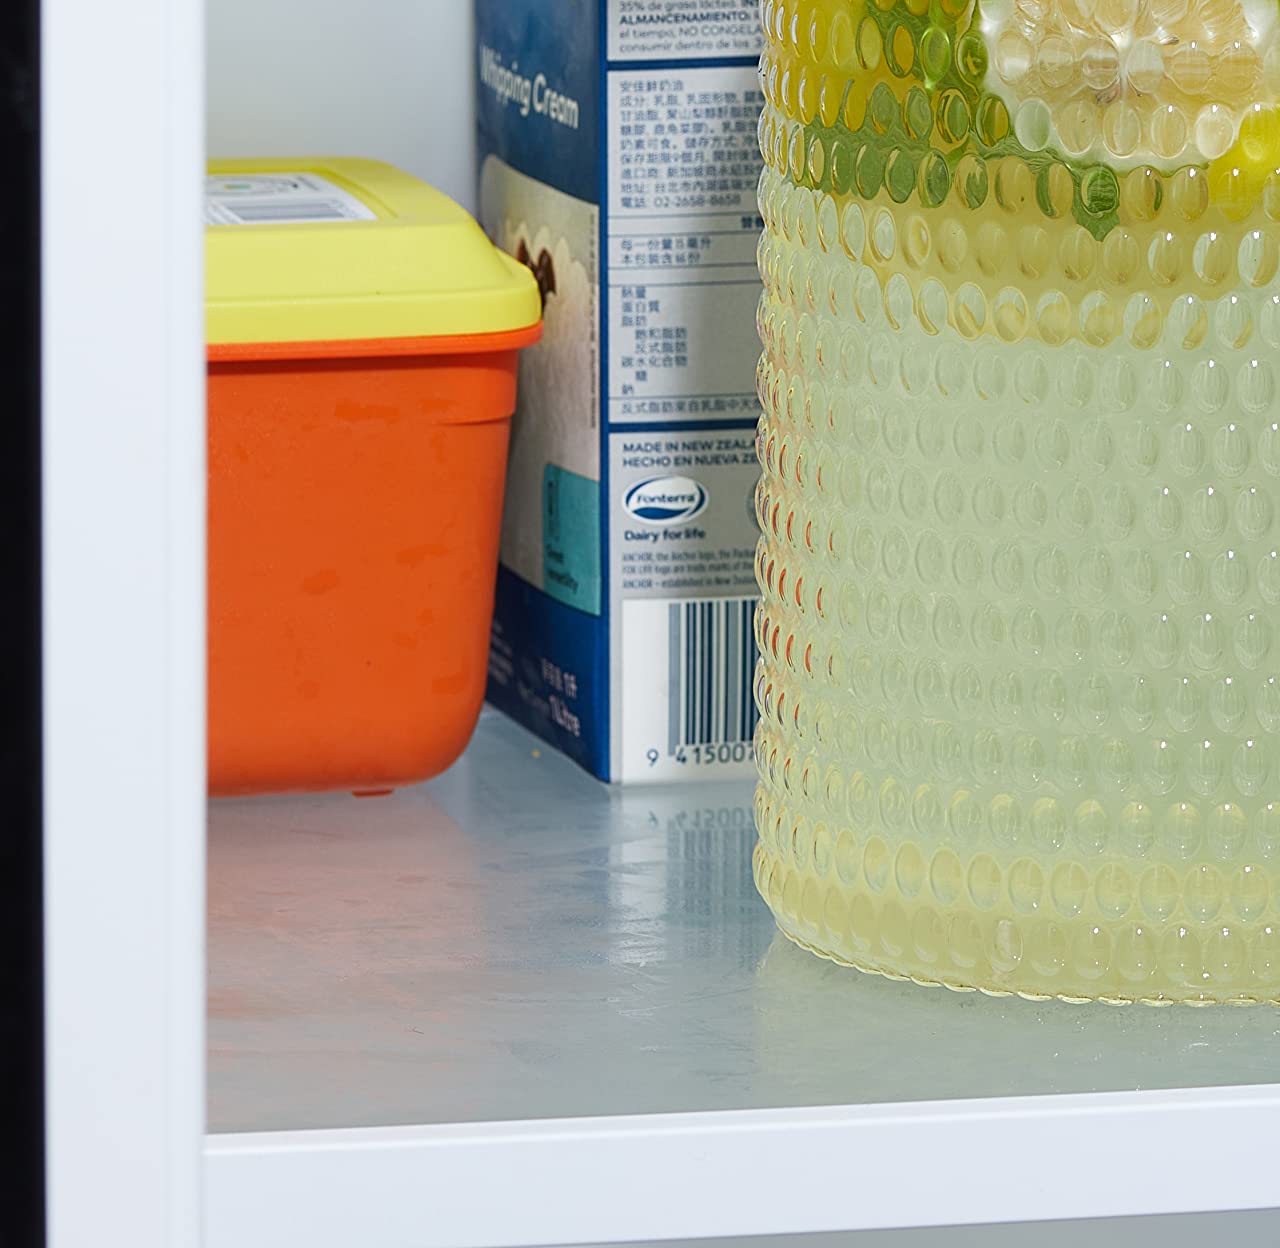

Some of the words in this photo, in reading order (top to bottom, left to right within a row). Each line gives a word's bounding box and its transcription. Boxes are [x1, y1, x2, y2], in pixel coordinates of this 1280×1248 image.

[648, 0, 662, 11] de
[620, 28, 630, 38] el
[678, 27, 698, 37] NO
[620, 40, 673, 53] consumir
[675, 38, 712, 49] dentro
[715, 38, 729, 49] de
[480, 45, 531, 117] Whipping
[533, 73, 580, 129] Cream
[623, 441, 661, 453] MADE
[665, 440, 678, 452] IN
[681, 439, 714, 452] NEW
[623, 455, 671, 467] HECHO
[674, 454, 692, 466] EN
[695, 453, 740, 465] NUEVA
[637, 493, 697, 504] Fonterra
[624, 529, 658, 543] Dairy
[663, 528, 682, 540] for
[684, 527, 706, 539] life
[646, 748, 658, 767] 9
